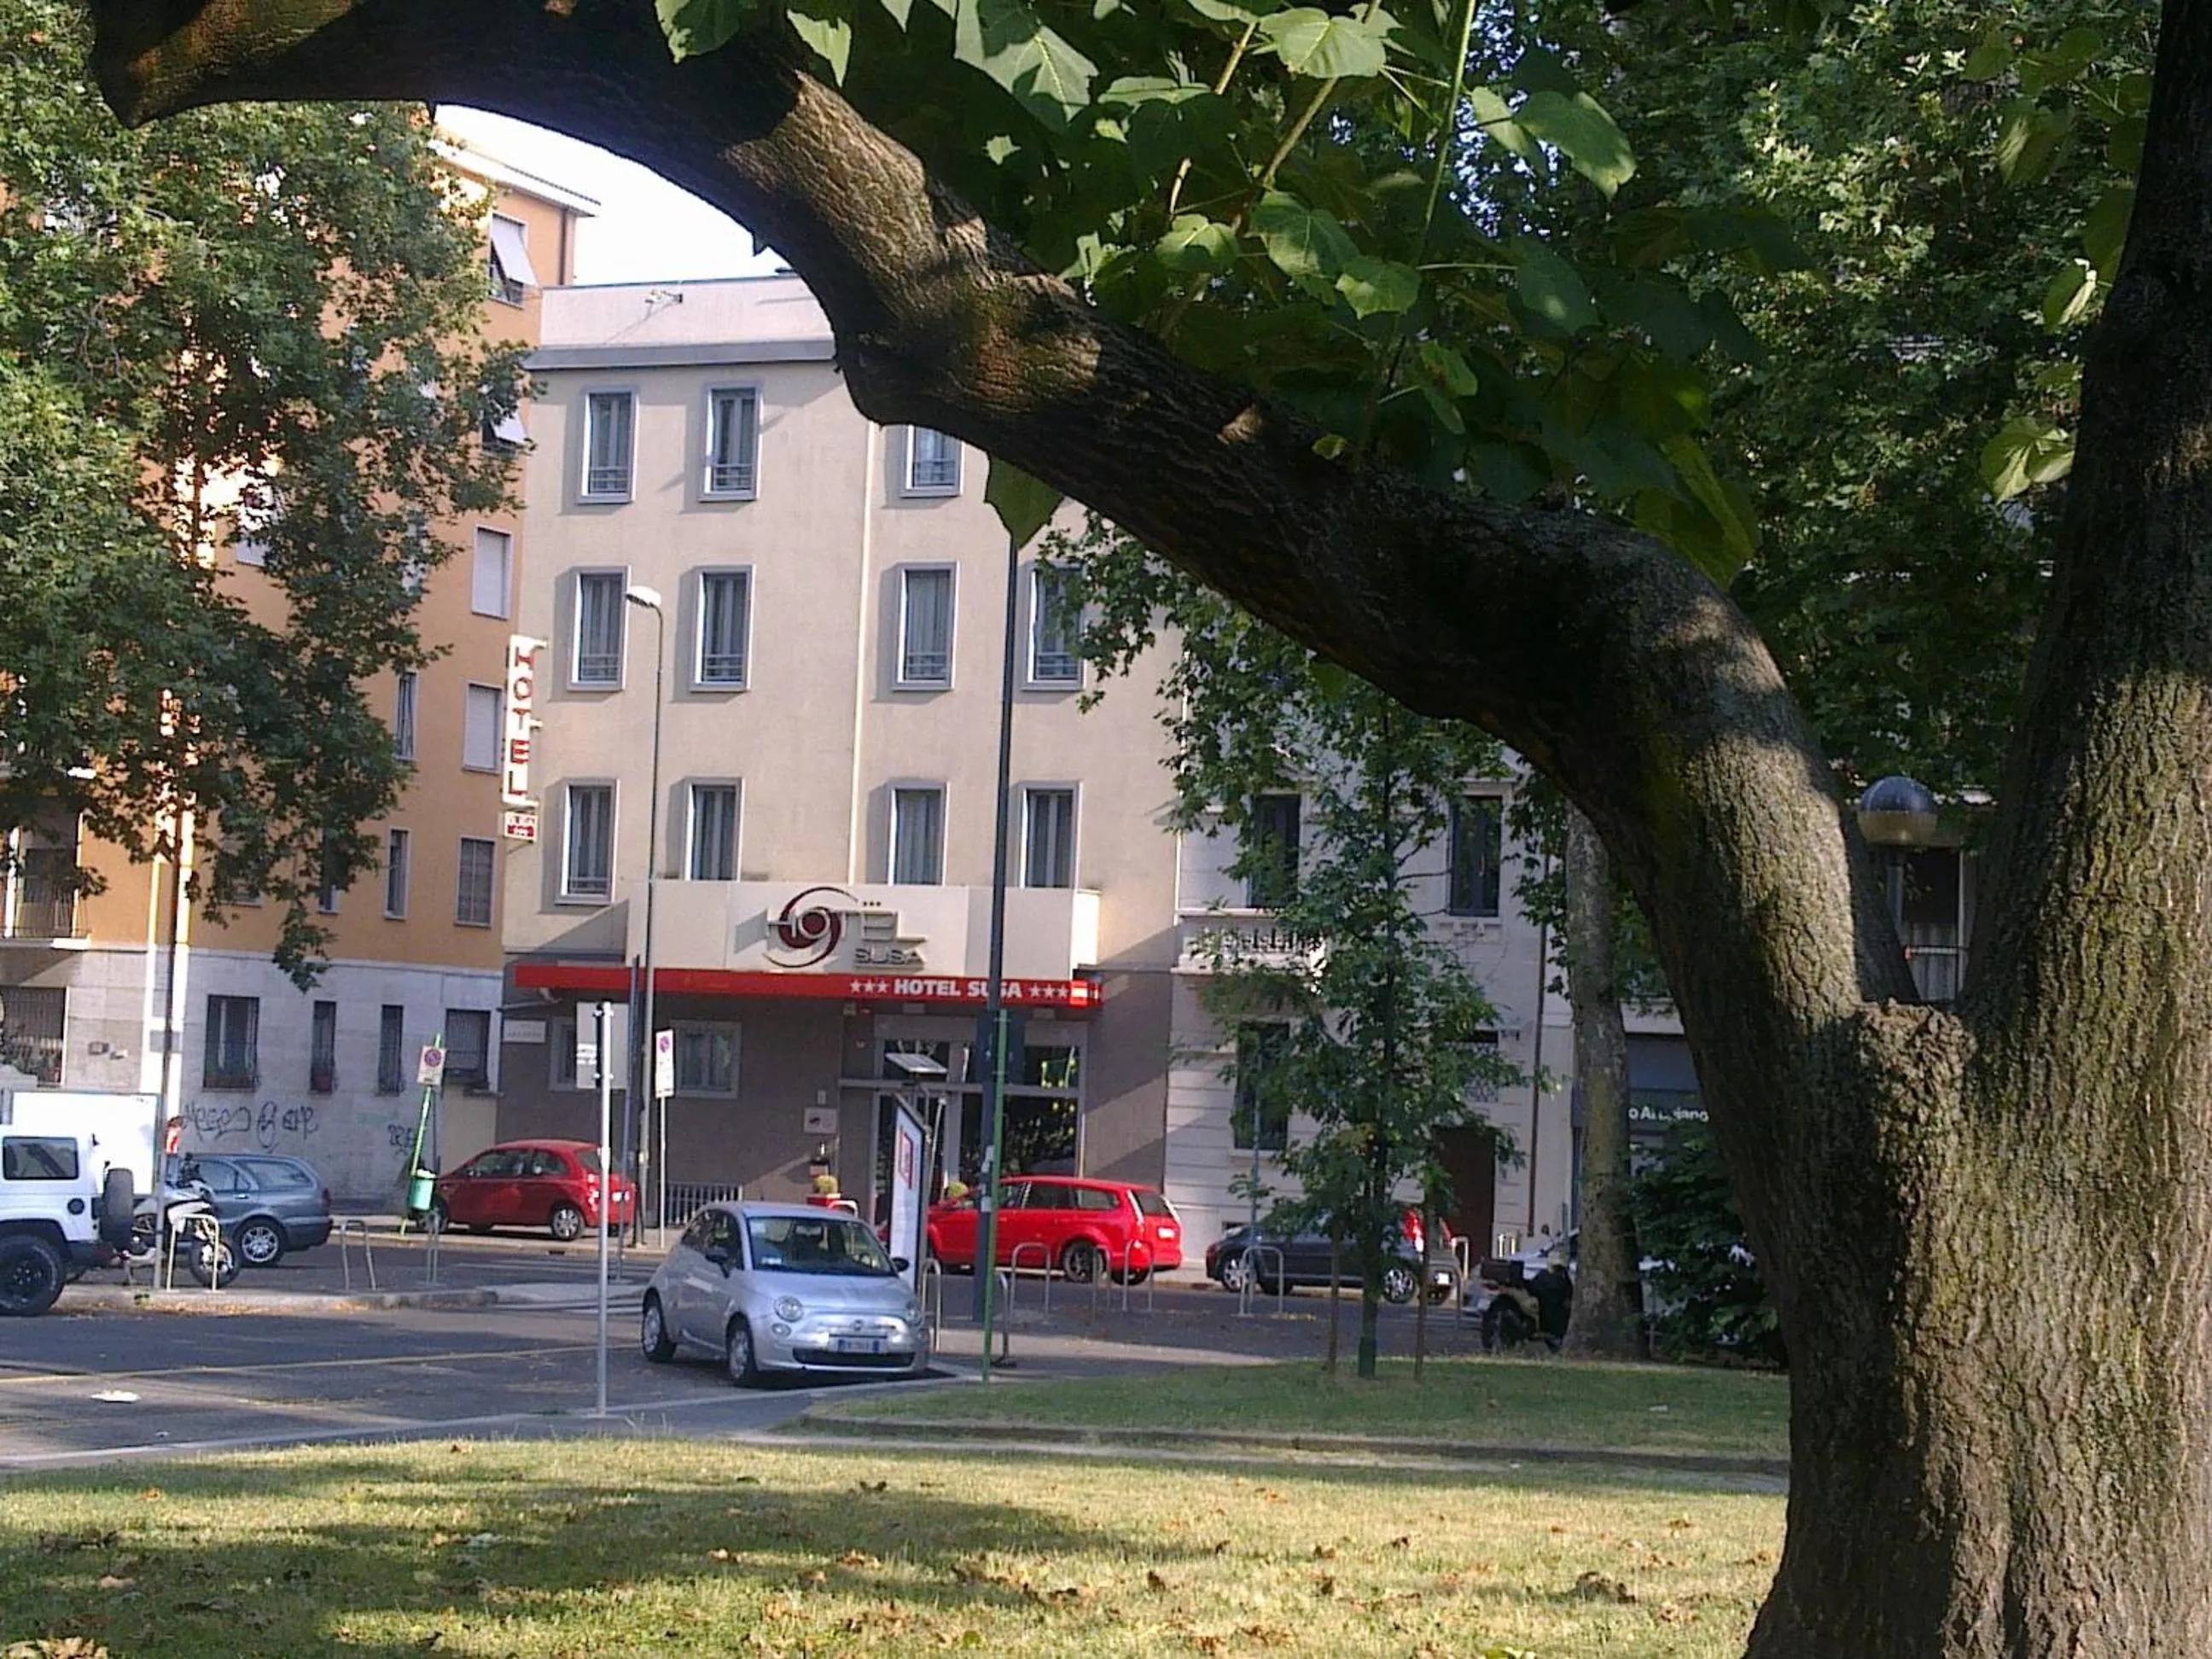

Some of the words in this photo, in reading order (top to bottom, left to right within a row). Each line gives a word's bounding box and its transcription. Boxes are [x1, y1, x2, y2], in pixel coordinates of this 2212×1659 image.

[508, 646, 534, 795] HOTEL
[765, 908, 928, 944] HOTEL
[854, 946, 928, 965] SUSA
[894, 979, 961, 998] HOTEL
